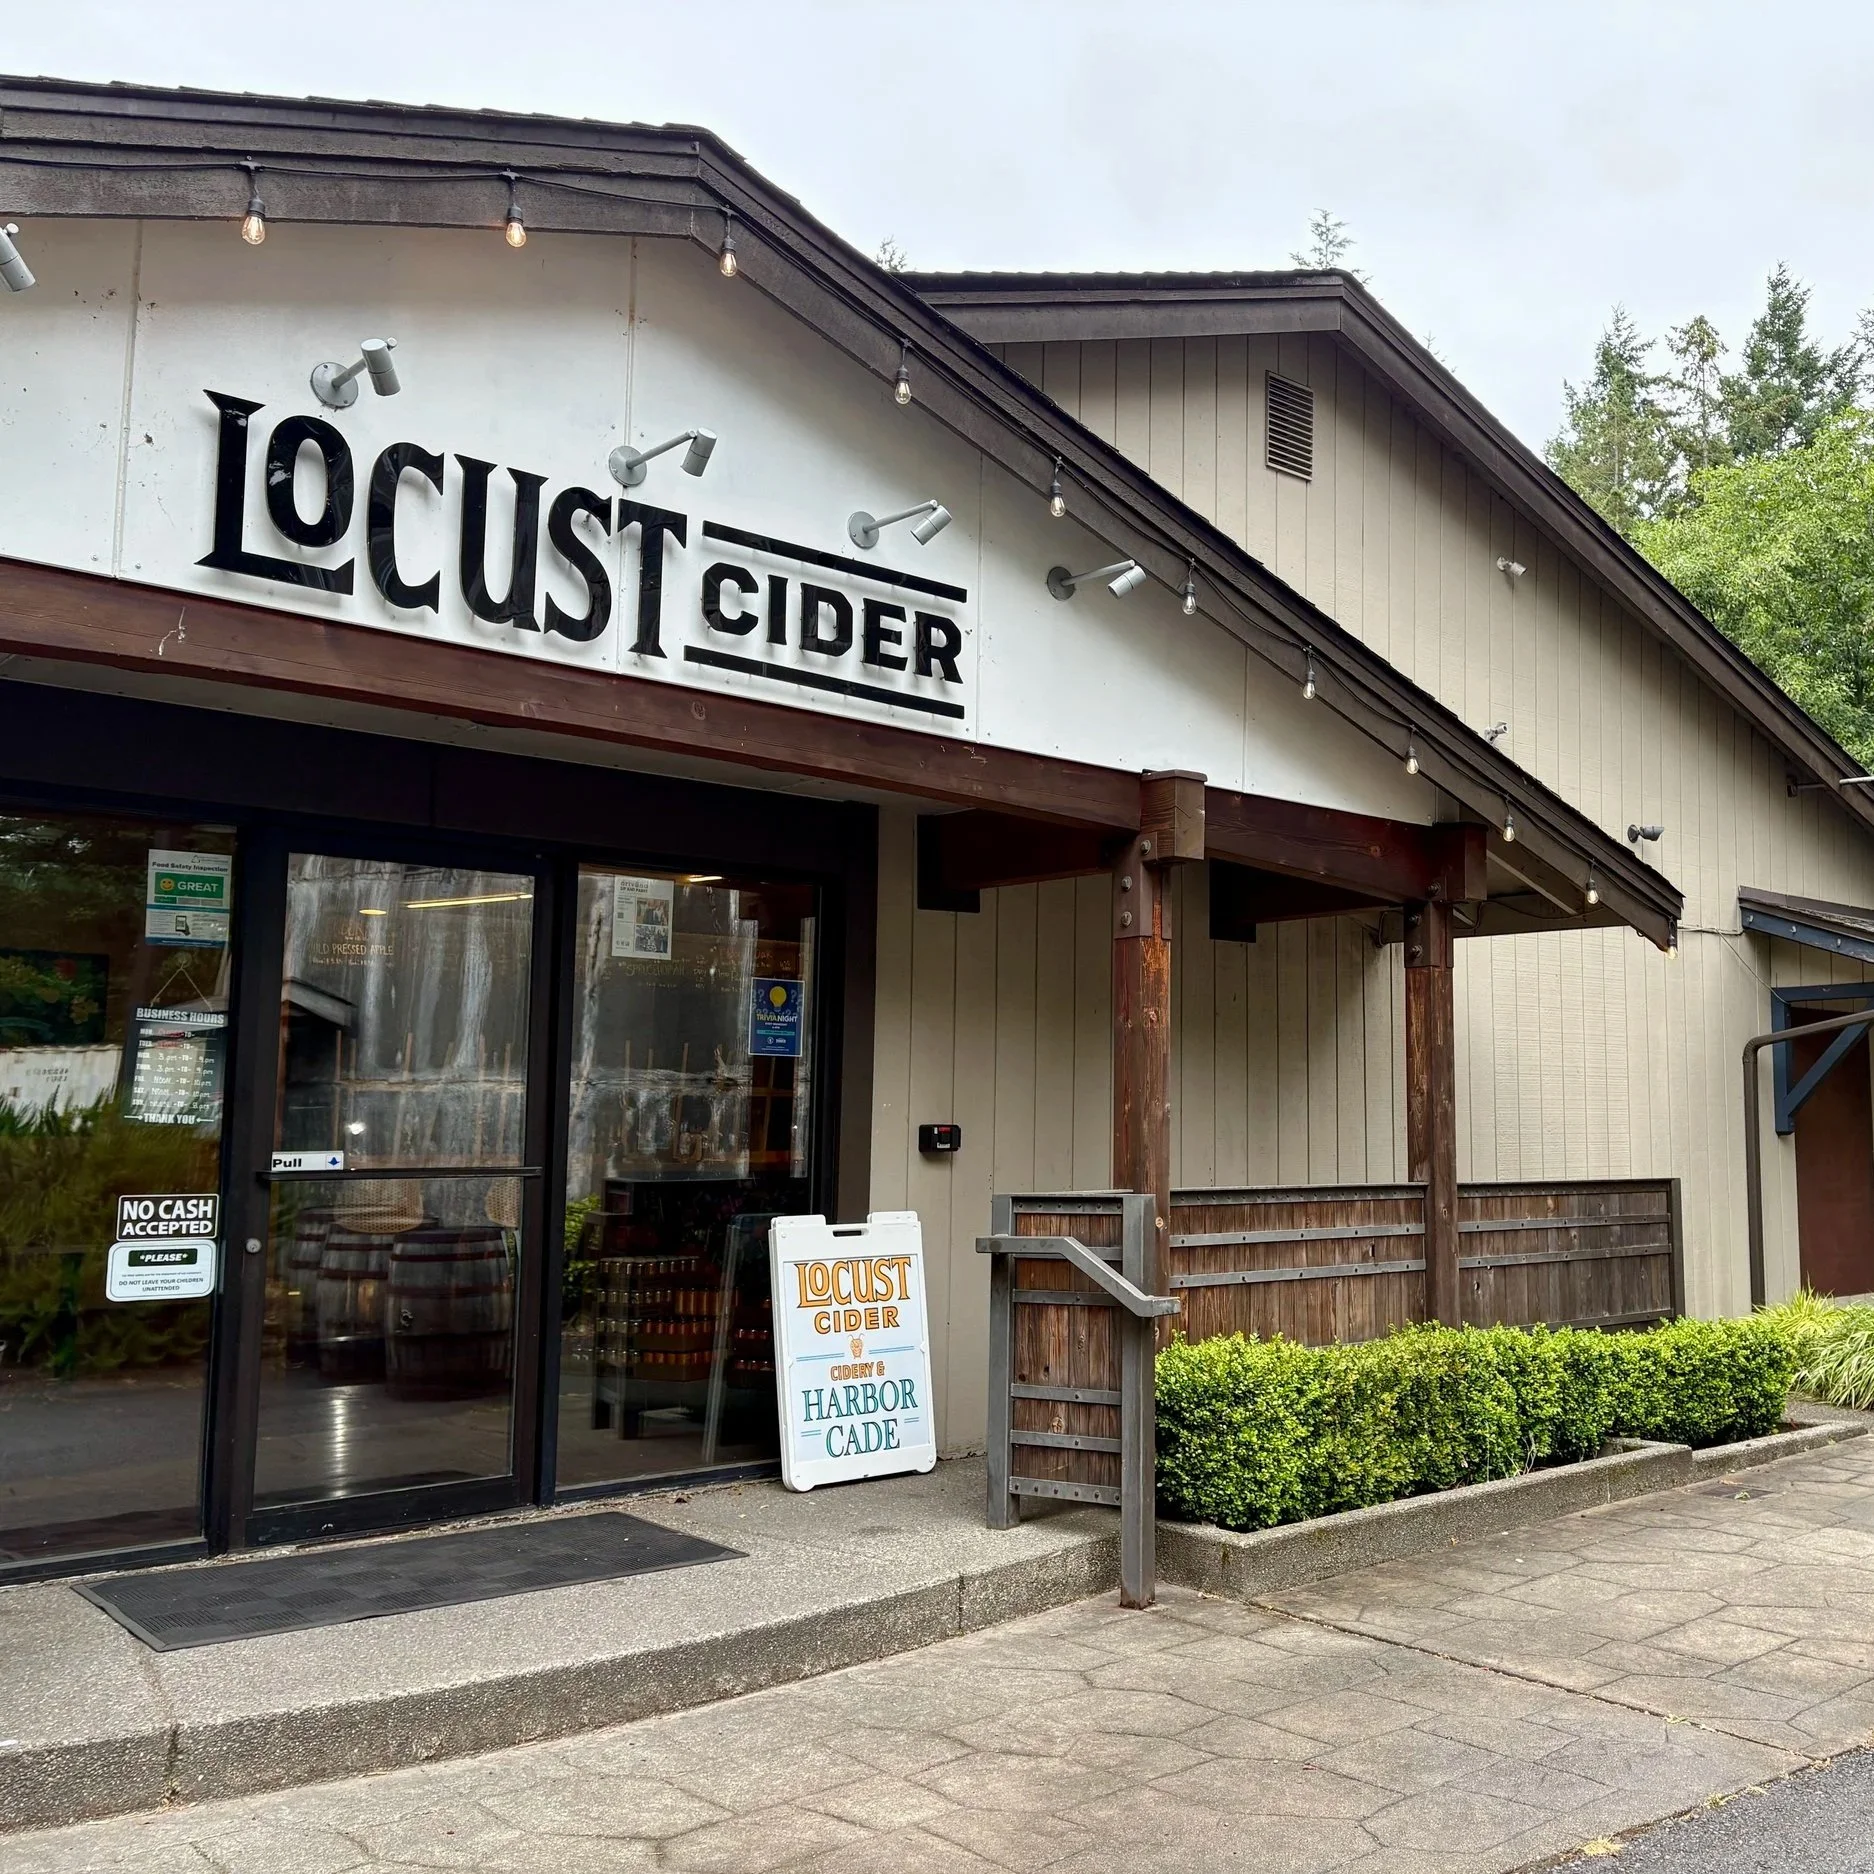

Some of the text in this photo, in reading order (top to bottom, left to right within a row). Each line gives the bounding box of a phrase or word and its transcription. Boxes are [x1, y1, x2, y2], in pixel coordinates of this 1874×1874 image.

[194, 389, 687, 659] LOCUST
[700, 562, 964, 685] CIDER
[178, 882, 218, 892] GREAT
[332, 943, 366, 955] PRESSED
[370, 944, 394, 956] APPLE
[136, 1008, 224, 1024] BUSINESS HOURS
[757, 1013, 777, 1021] TRIVIA
[144, 1113, 196, 1124] THANK YOU
[273, 1158, 302, 1168] Pull
[122, 1200, 212, 1220] NO CASH
[122, 1220, 213, 1236] ACCEPTED
[794, 1256, 911, 1308] LOCUST
[814, 1306, 900, 1334] CIDER
[831, 1360, 885, 1381] CIDERY &
[802, 1378, 918, 1422] HARBOR
[826, 1418, 900, 1458] CADE
